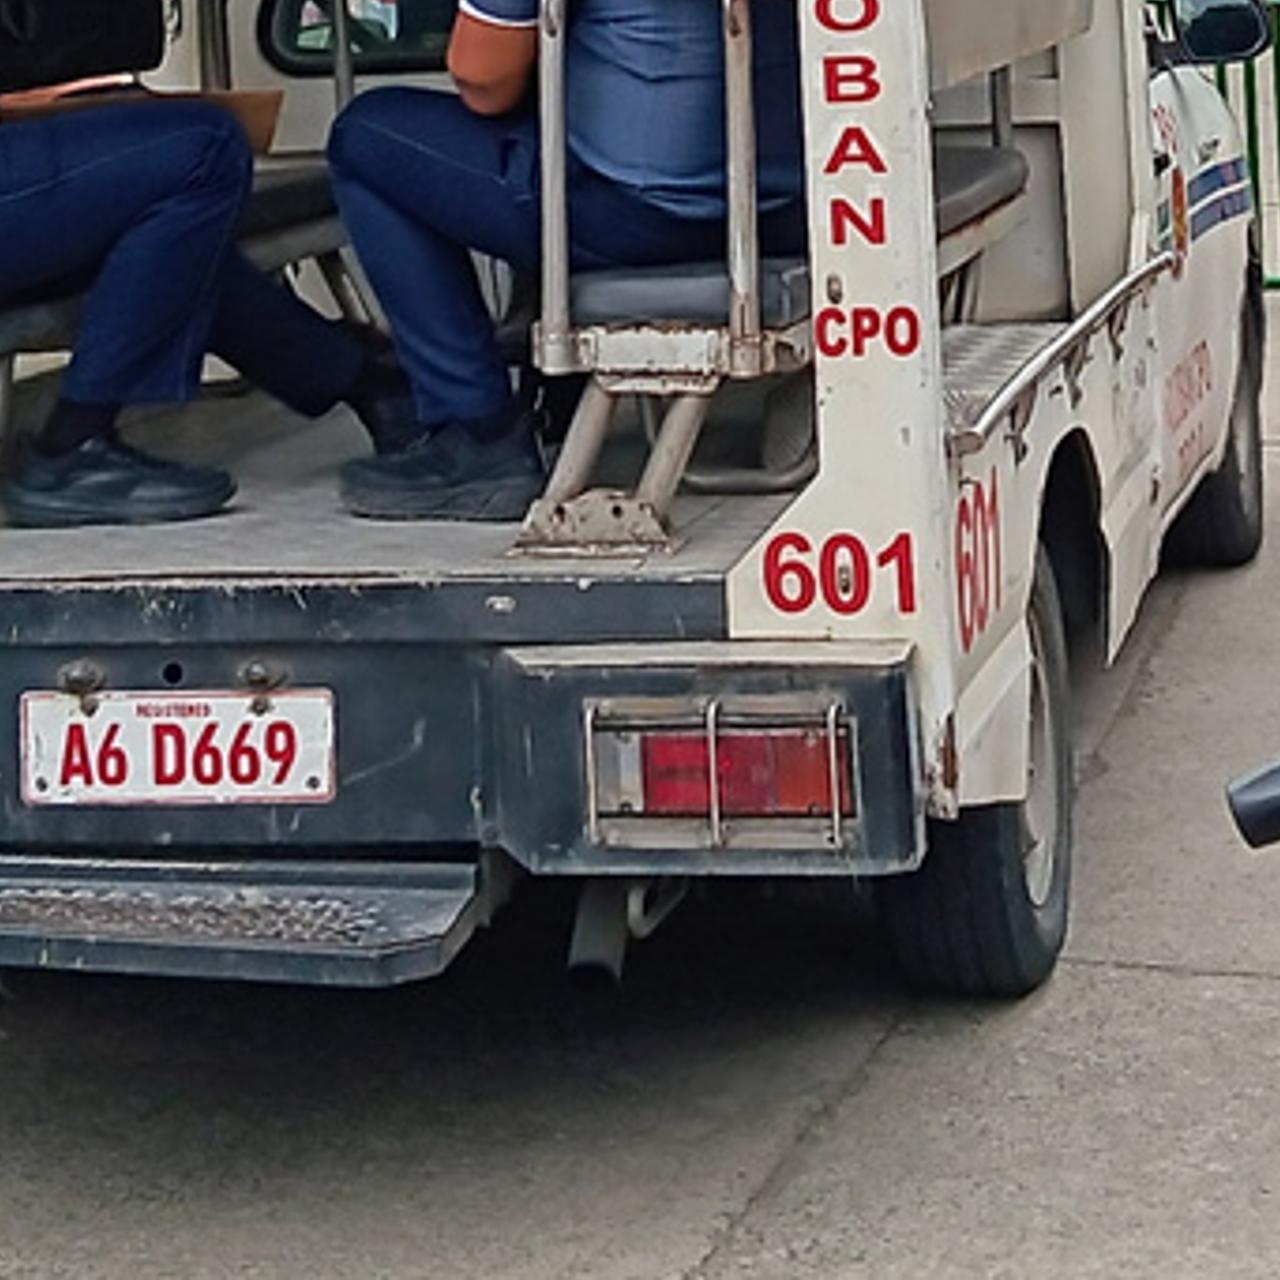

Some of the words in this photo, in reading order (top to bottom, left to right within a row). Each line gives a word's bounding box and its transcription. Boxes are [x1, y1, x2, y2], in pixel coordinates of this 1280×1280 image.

[815, 306, 920, 358] CPO
[763, 531, 916, 614] 601
[955, 466, 1002, 652] 601
[60, 722, 128, 786] A6
[152, 721, 297, 786] D669
